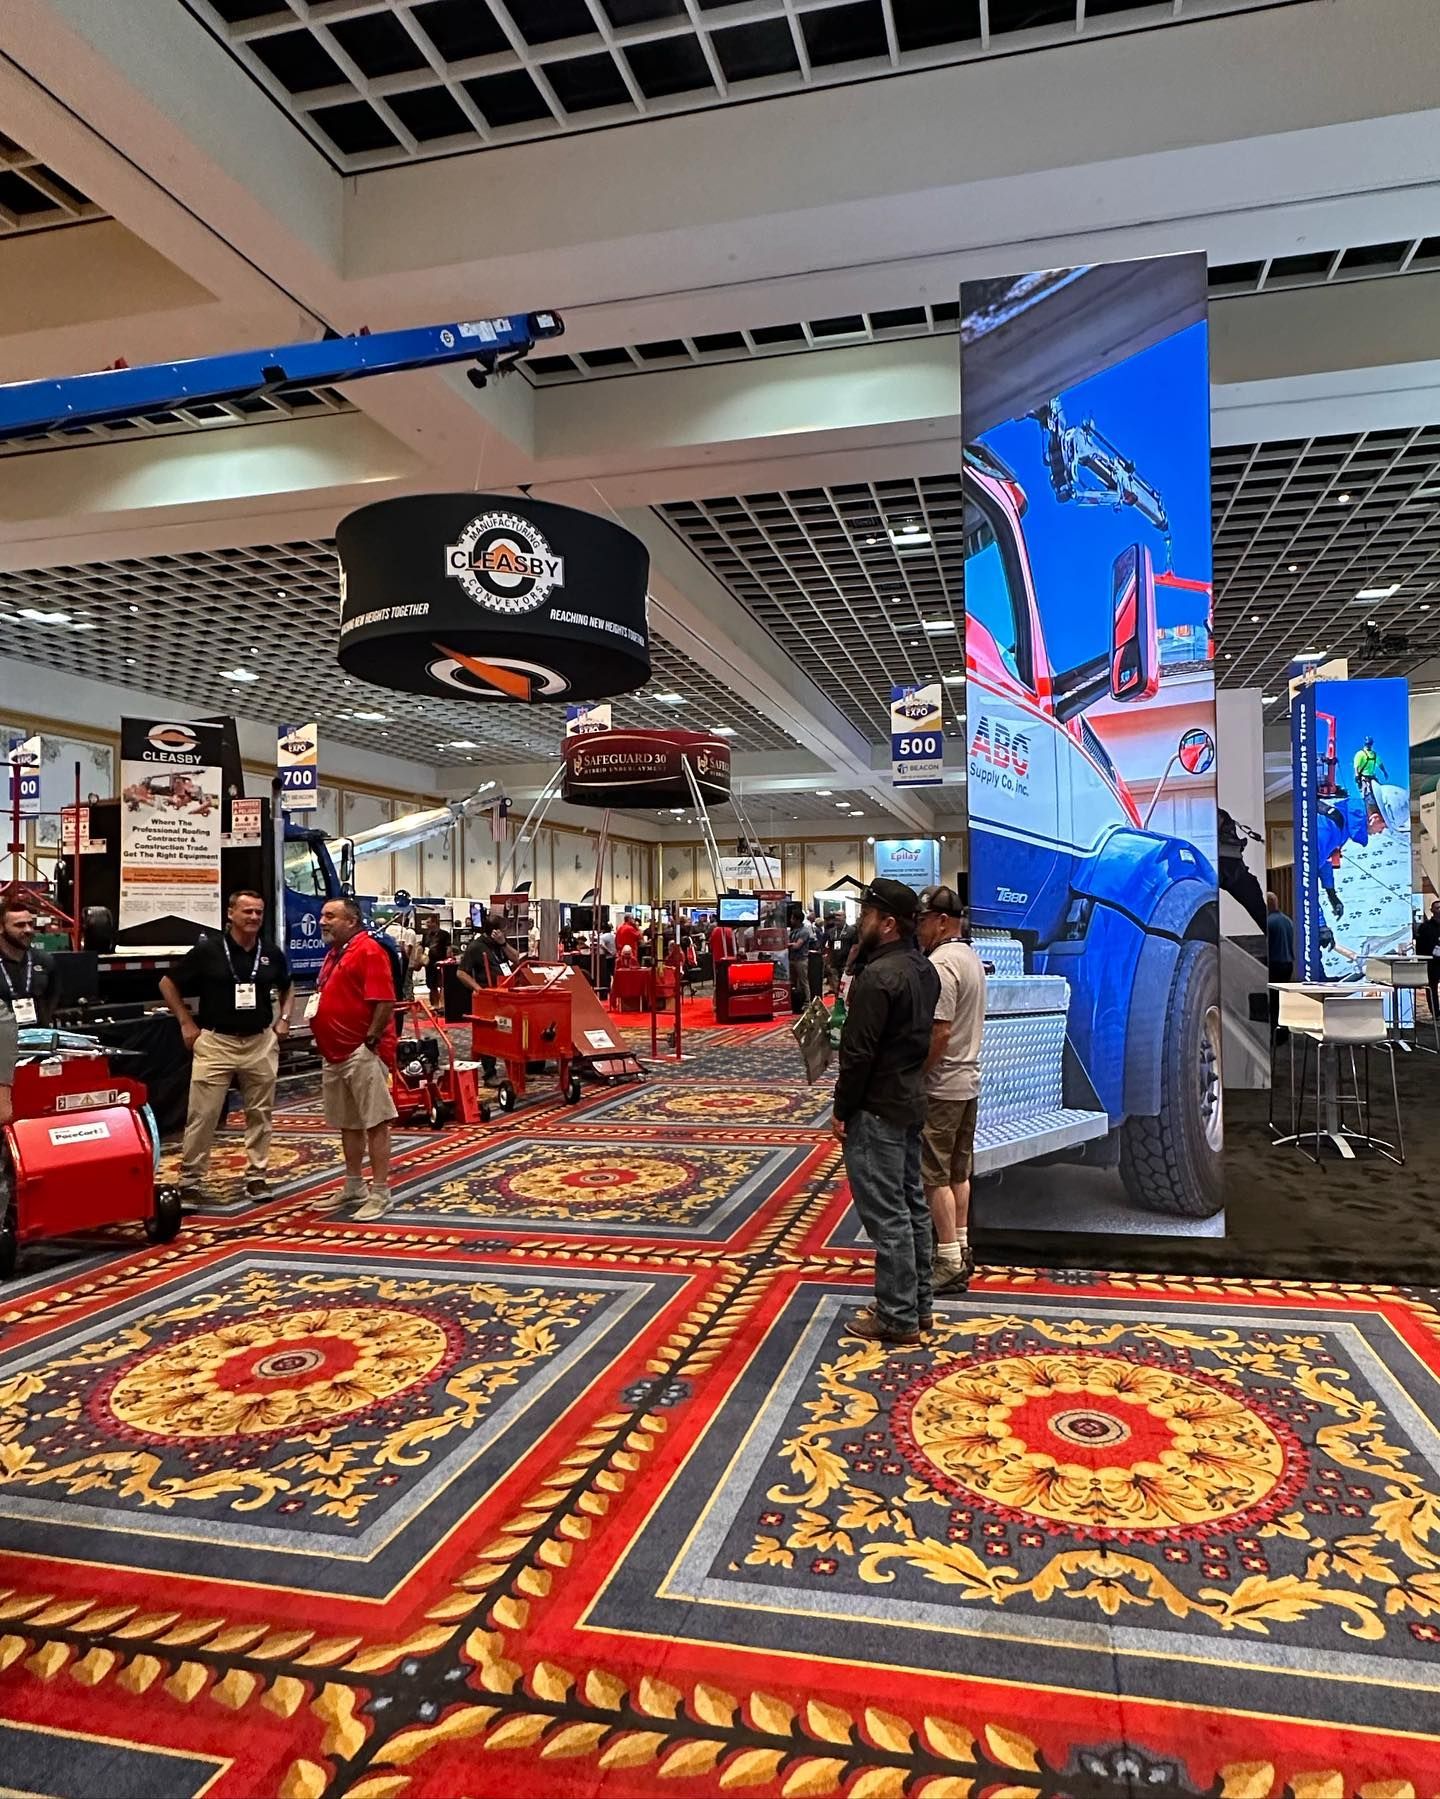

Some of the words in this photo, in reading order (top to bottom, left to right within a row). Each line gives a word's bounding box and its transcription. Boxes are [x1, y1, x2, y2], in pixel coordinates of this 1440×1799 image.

[469, 519, 540, 549] MANUFACTURING
[450, 551, 559, 578] CLEASBY
[468, 578, 544, 607] CONVEYORS
[365, 607, 390, 624] HEIGHTS
[391, 603, 430, 619] TOGETHER
[550, 608, 589, 626] REACHING
[589, 616, 605, 630] NEW
[605, 620, 628, 638] HEIGHTS
[905, 708, 928, 717] EXPO
[1299, 703, 1307, 743] Time
[899, 737, 936, 755] 500
[968, 716, 1031, 777] ABC
[142, 751, 202, 765] CLEASBY
[583, 752, 653, 767] SAFEGUARD
[655, 753, 667, 764] 30
[1300, 745, 1308, 788] Right
[283, 770, 312, 786] 700
[969, 761, 1000, 788] Supply
[1001, 774, 1014, 791] Co.
[20, 780, 37, 795] 00
[151, 818, 176, 826] Where
[132, 826, 180, 834] Professional
[182, 828, 211, 837] Roofing
[146, 835, 189, 843] Contractor
[134, 843, 185, 851] Construction
[156, 852, 177, 860] Right
[178, 852, 219, 860] Equipment
[890, 852, 919, 862] Epilay
[1302, 845, 1310, 888] Right
[996, 886, 1029, 904] T880
[1303, 899, 1311, 962] Product
[289, 938, 326, 950] BEACON
